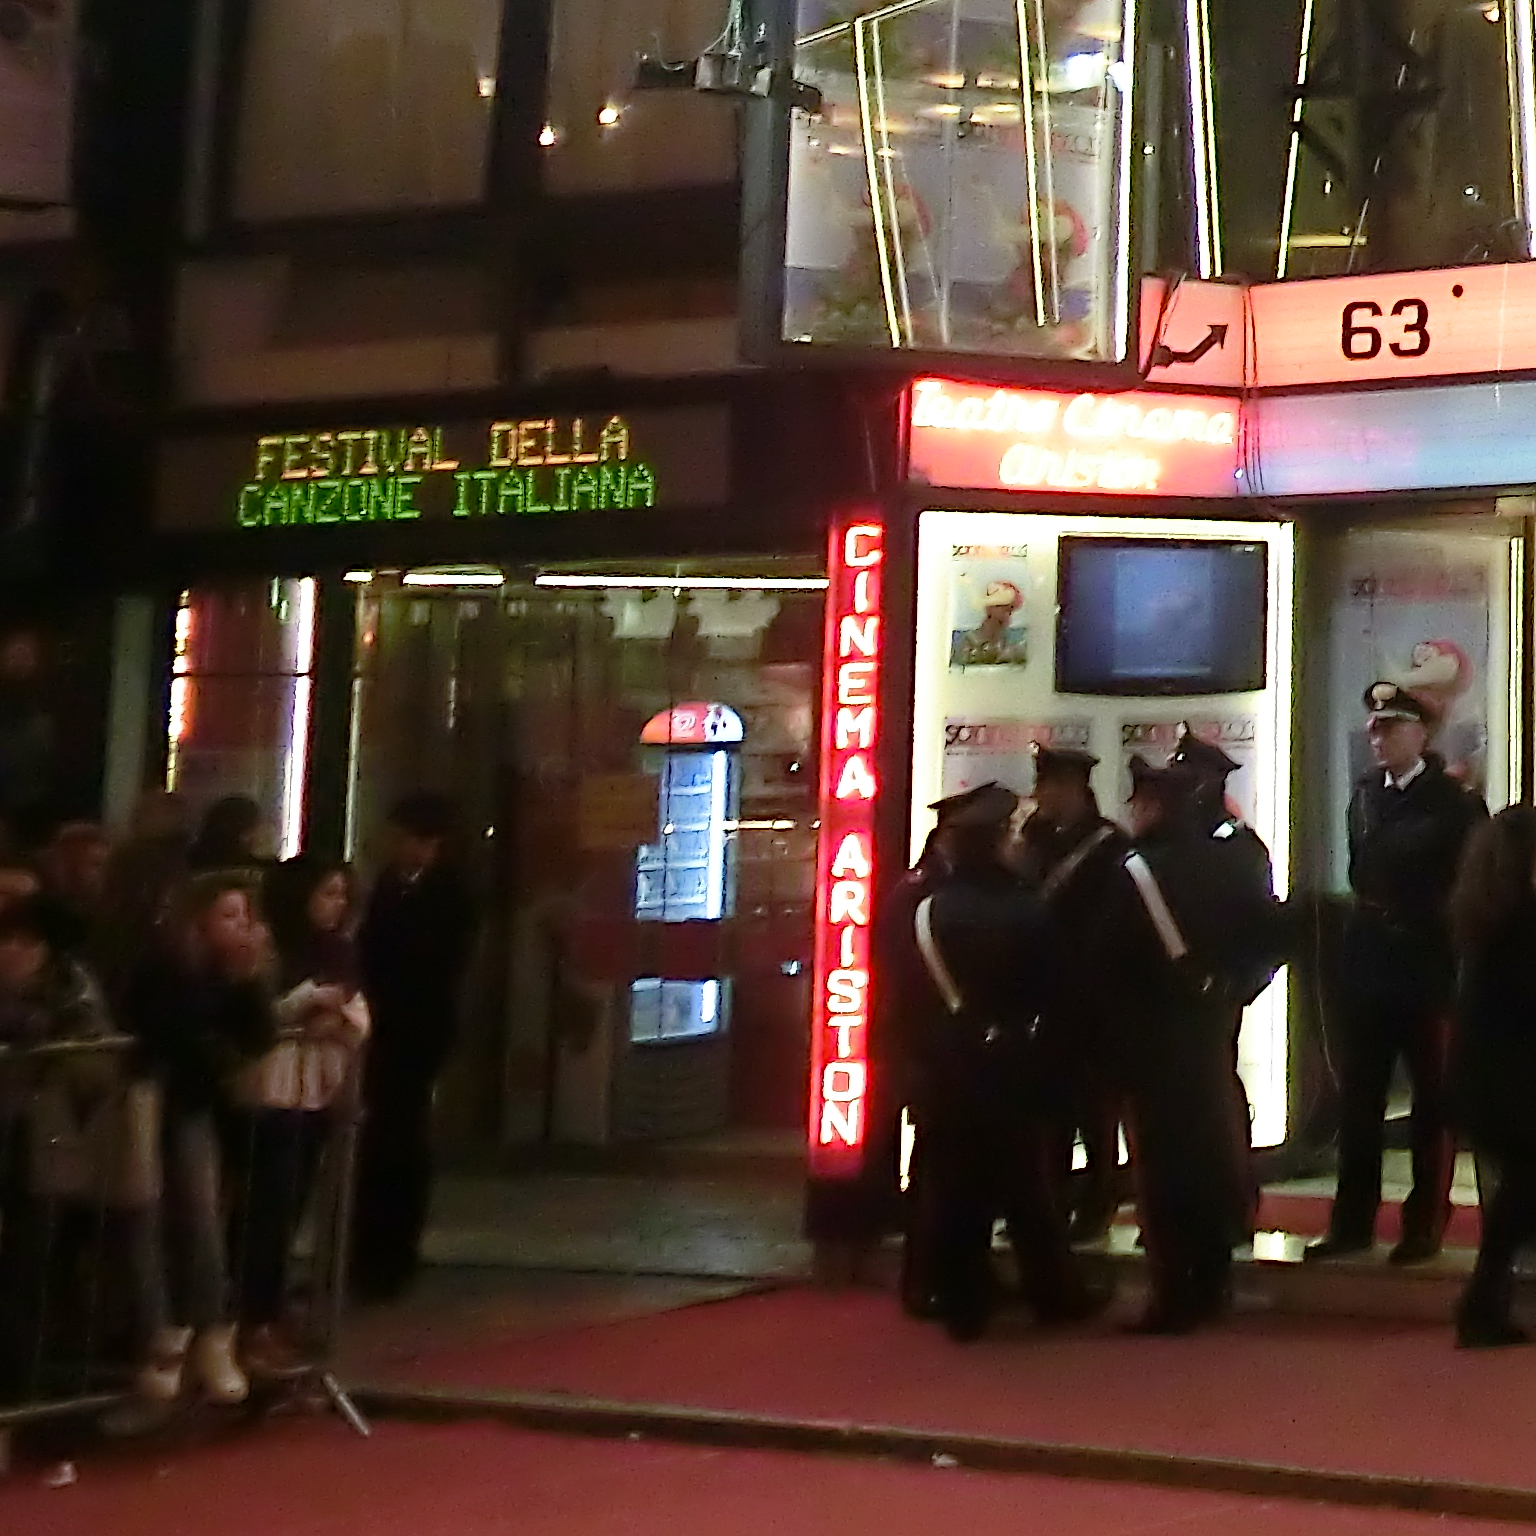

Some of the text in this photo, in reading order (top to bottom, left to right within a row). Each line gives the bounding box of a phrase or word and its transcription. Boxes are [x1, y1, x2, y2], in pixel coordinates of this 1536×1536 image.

[237, 463, 657, 528] CANZONE ITALIANA
[256, 414, 630, 480] FESTIVAL DELLA
[834, 524, 883, 800] CINEMA
[820, 830, 869, 1146] ARISTON
